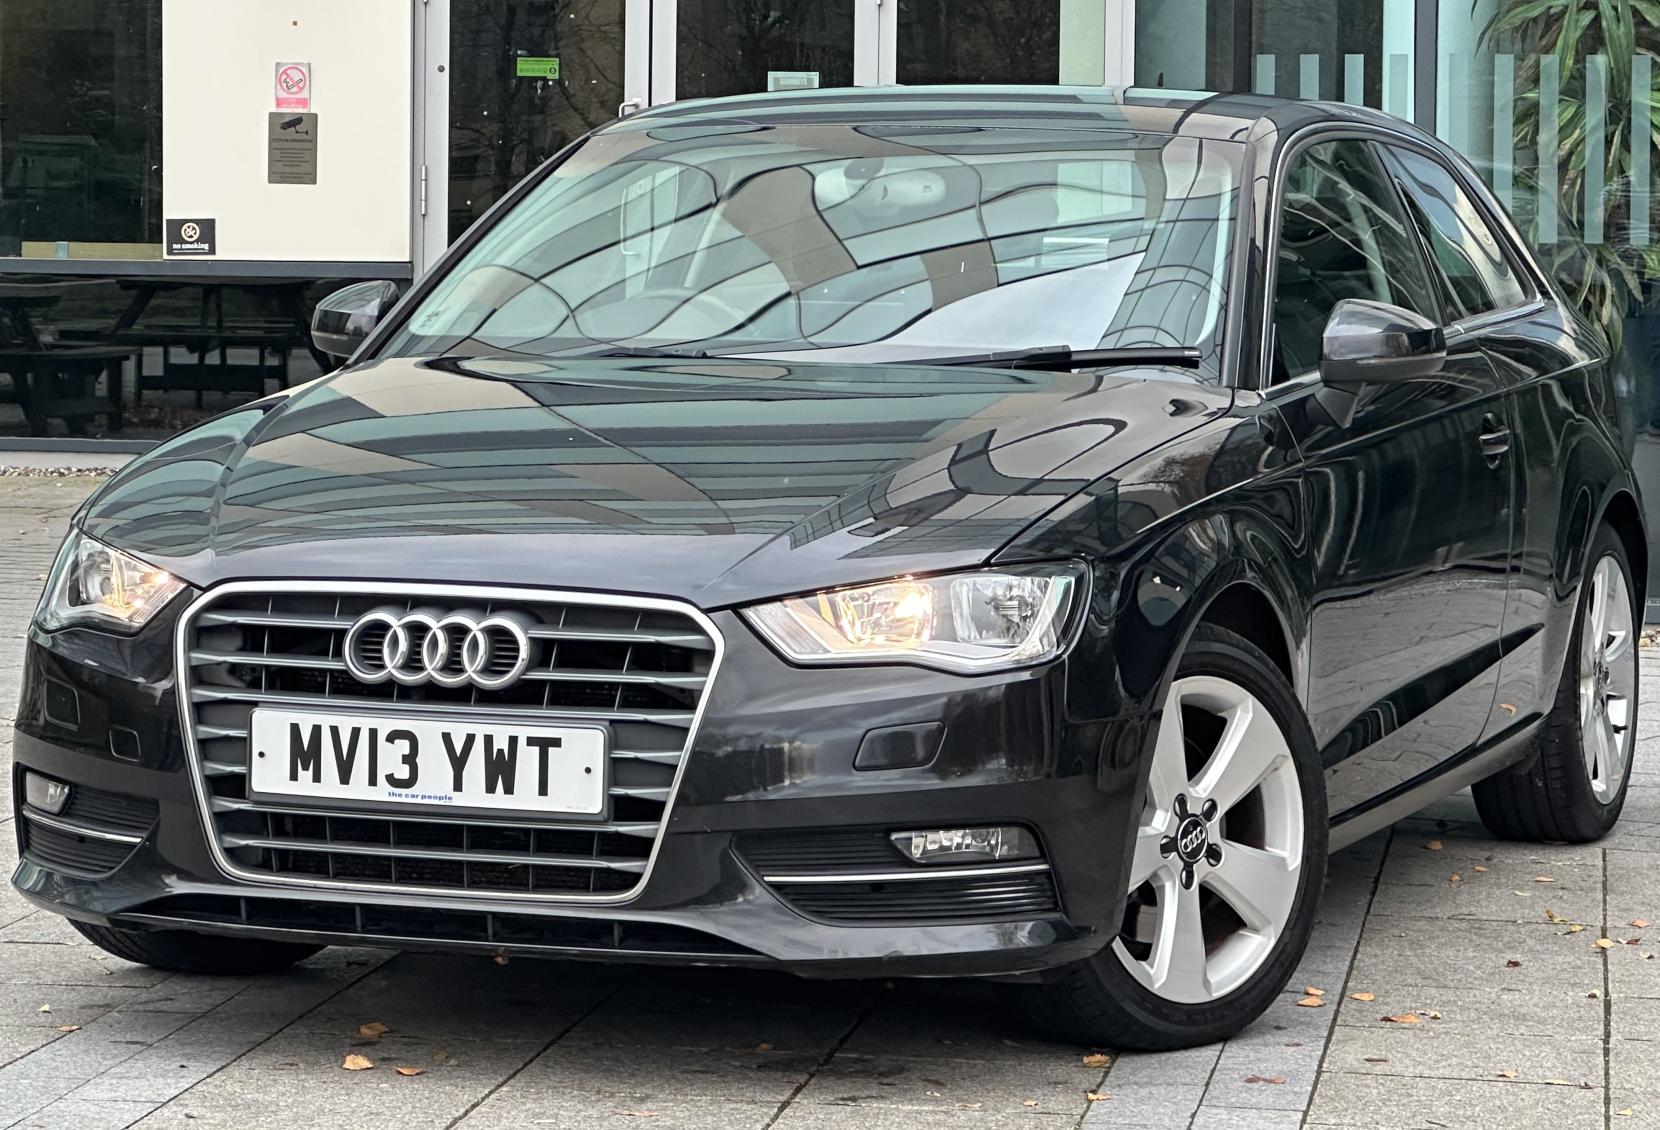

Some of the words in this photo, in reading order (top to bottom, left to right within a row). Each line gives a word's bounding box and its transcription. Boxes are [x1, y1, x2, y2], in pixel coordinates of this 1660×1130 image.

[181, 241, 209, 250] smoking
[289, 722, 419, 790] MV13
[441, 731, 563, 797] YWT
[421, 794, 453, 802] people
